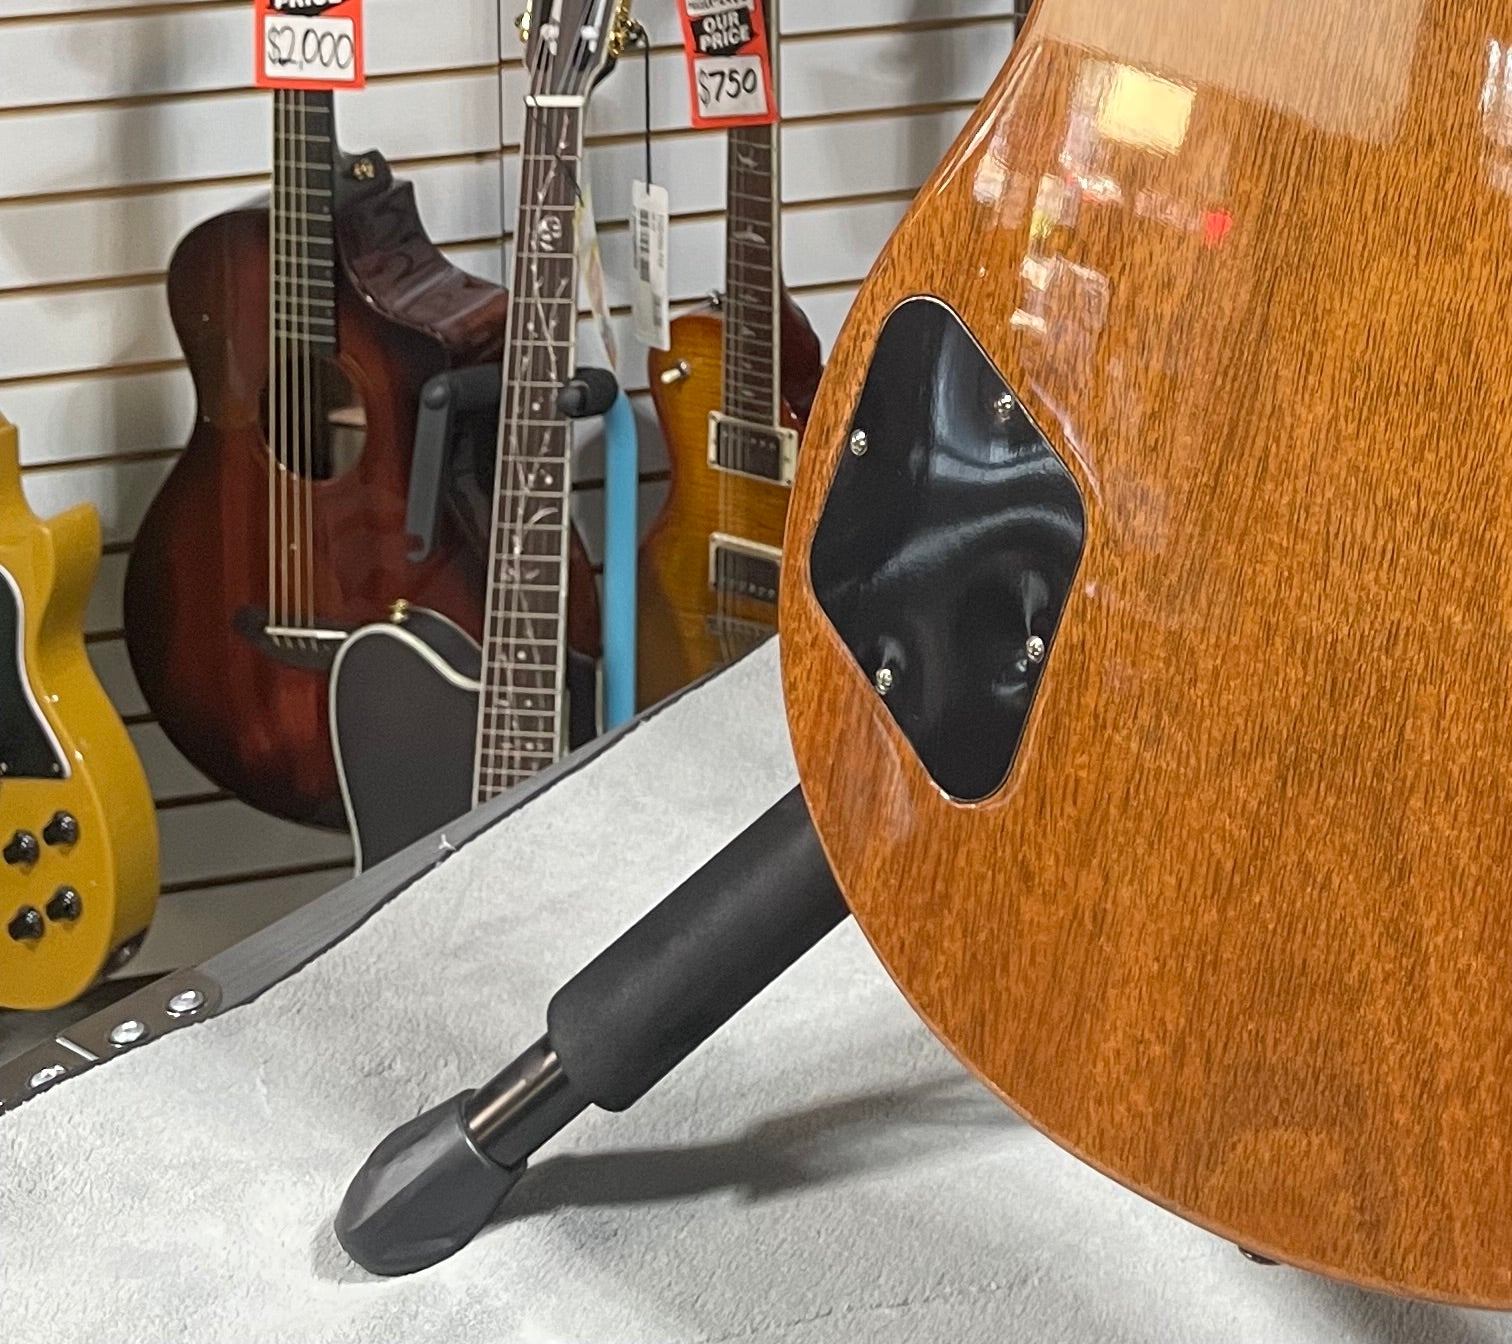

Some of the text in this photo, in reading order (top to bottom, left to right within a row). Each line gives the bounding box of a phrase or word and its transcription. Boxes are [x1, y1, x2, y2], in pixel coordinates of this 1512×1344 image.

[702, 10, 740, 34] OUR
[699, 24, 751, 53] PRICE
[698, 67, 758, 108] $750
